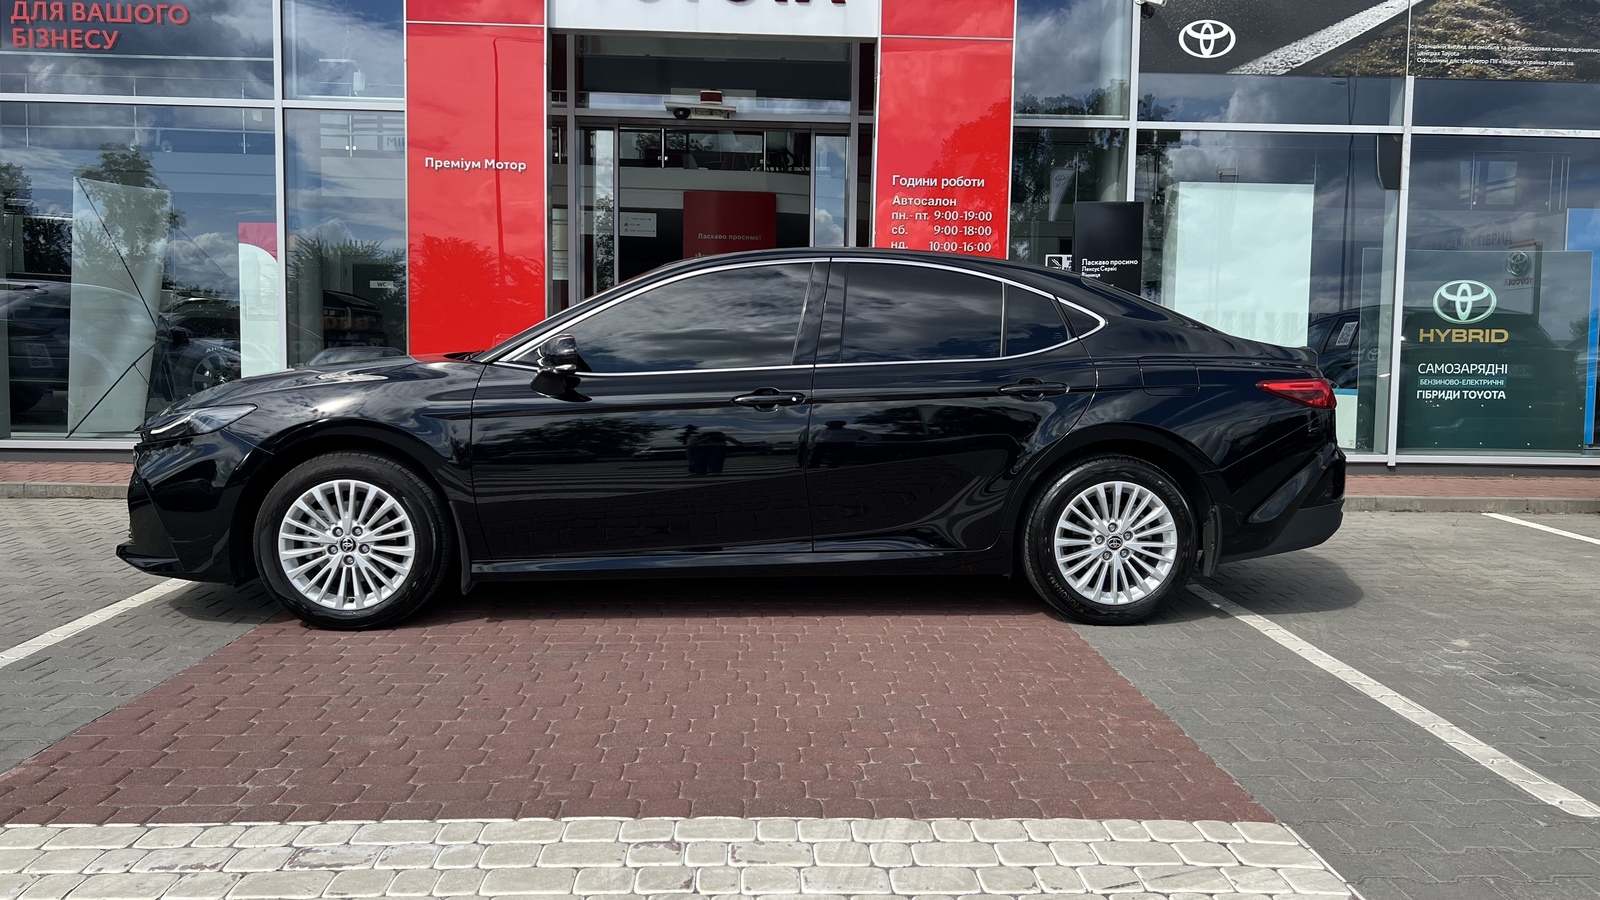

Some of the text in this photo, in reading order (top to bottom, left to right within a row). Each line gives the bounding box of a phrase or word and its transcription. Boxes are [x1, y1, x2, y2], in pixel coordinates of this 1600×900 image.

[11, 1, 189, 25] ДЛЯ ВАШОГО
[13, 28, 119, 50] БІЗНЕСУ
[1441, 50, 1460, 58] Toyota
[425, 157, 527, 172] Преміум Мотор
[892, 175, 985, 189] Години роботи
[892, 195, 957, 206] Автосалон
[934, 210, 993, 221] 9:00-19:00
[891, 225, 992, 236] сб. 9:00-18:00
[891, 241, 992, 252] нд. 10:00-16:00
[1082, 258, 1139, 267] Ласкаво просимо
[1419, 328, 1509, 343] HYBRID
[1417, 363, 1508, 376] САМОЗАРЯДНІ
[1419, 378, 1505, 386] БЕНЗИНОВО-ЕЛЕКТРИЧНІ
[1416, 390, 1507, 400] ГІБРИДИ TOYOTA
